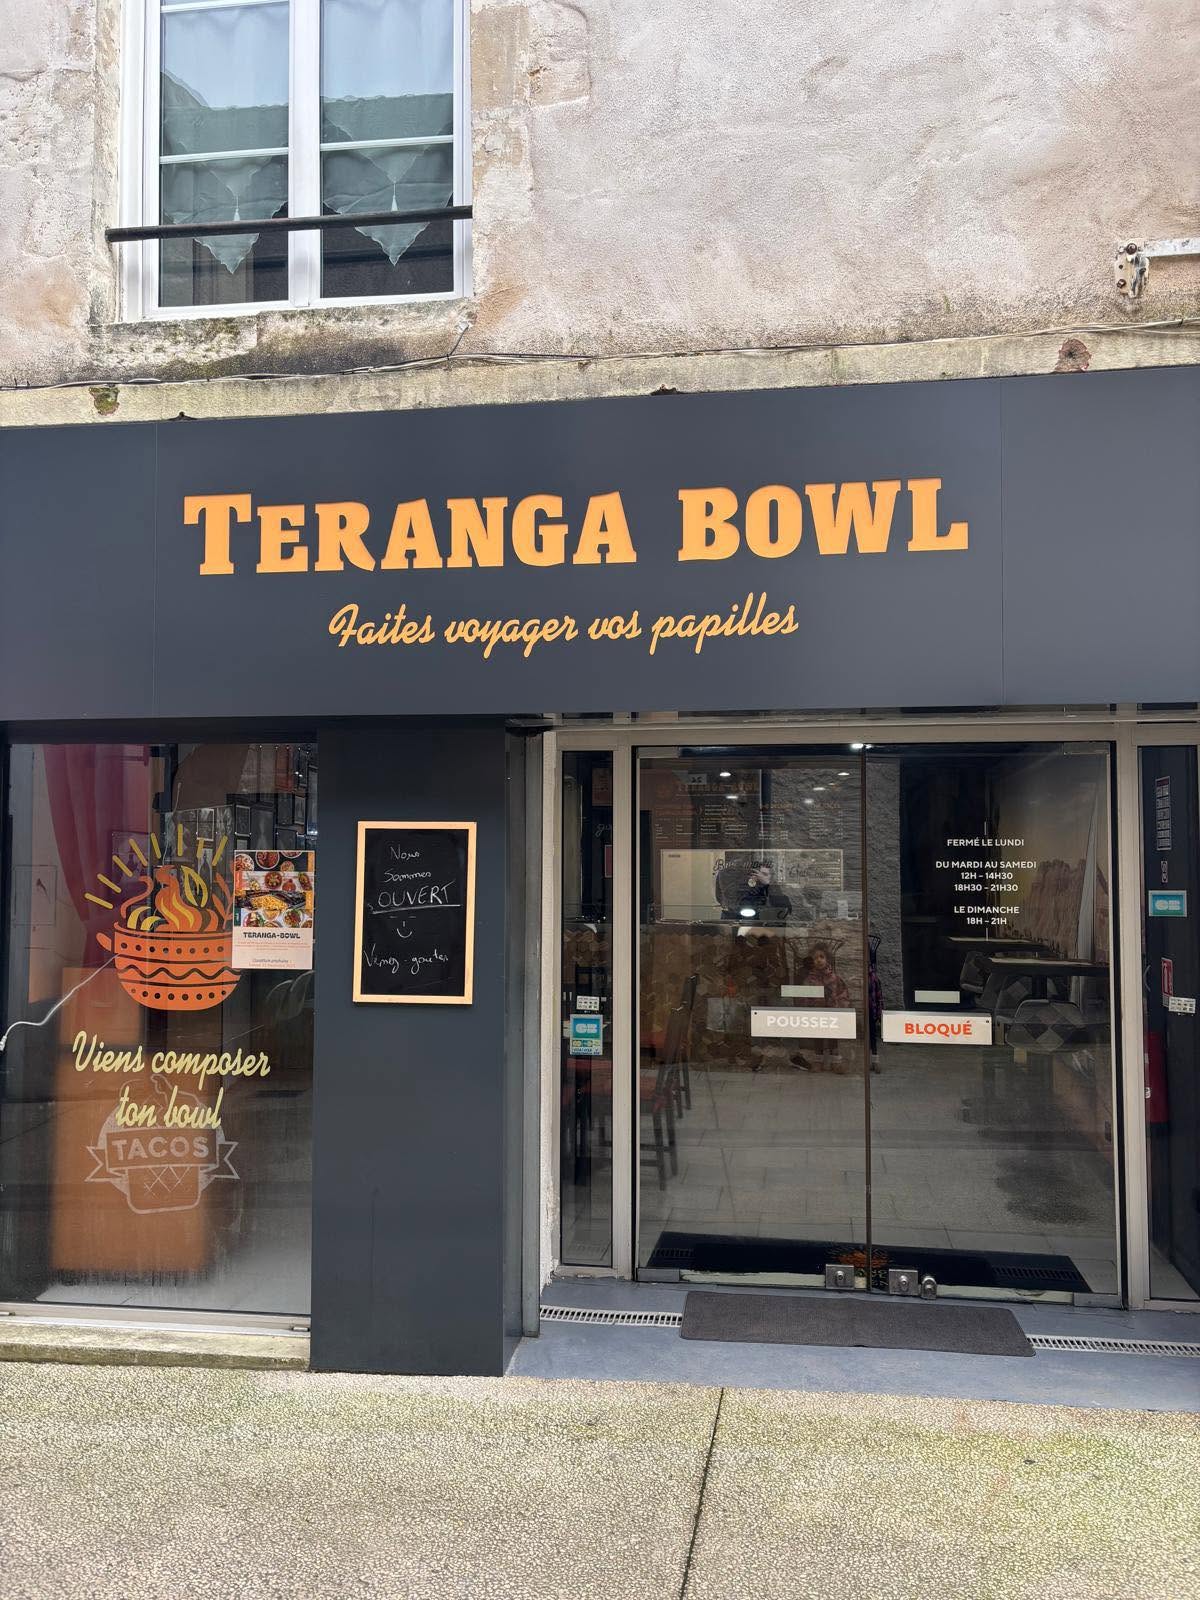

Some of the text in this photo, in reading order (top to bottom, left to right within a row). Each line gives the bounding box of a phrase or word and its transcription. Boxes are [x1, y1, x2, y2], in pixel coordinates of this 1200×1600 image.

[184, 478, 968, 575] TERANGA BOWL
[329, 593, 796, 657] Faites voyager vos papilles
[947, 837, 1025, 847] FERMÉ LE LUNDI
[935, 861, 1037, 869] DU MARDI AU SAMEDI
[961, 872, 977, 880] 12H
[985, 872, 1013, 880] 14H30
[378, 879, 456, 908] OUVERT
[954, 884, 983, 892] 18H30
[990, 884, 1019, 892] 21H30
[953, 906, 1020, 914] LE DIMANCHE
[966, 917, 983, 925] 18H
[991, 917, 1007, 925] 21H
[766, 1015, 840, 1029] POUSSEZ
[904, 1020, 973, 1037] BLOQUÉ
[72, 1030, 271, 1091] Viens composer
[115, 1085, 224, 1129] ton bowl
[111, 1136, 210, 1161] TACOS
